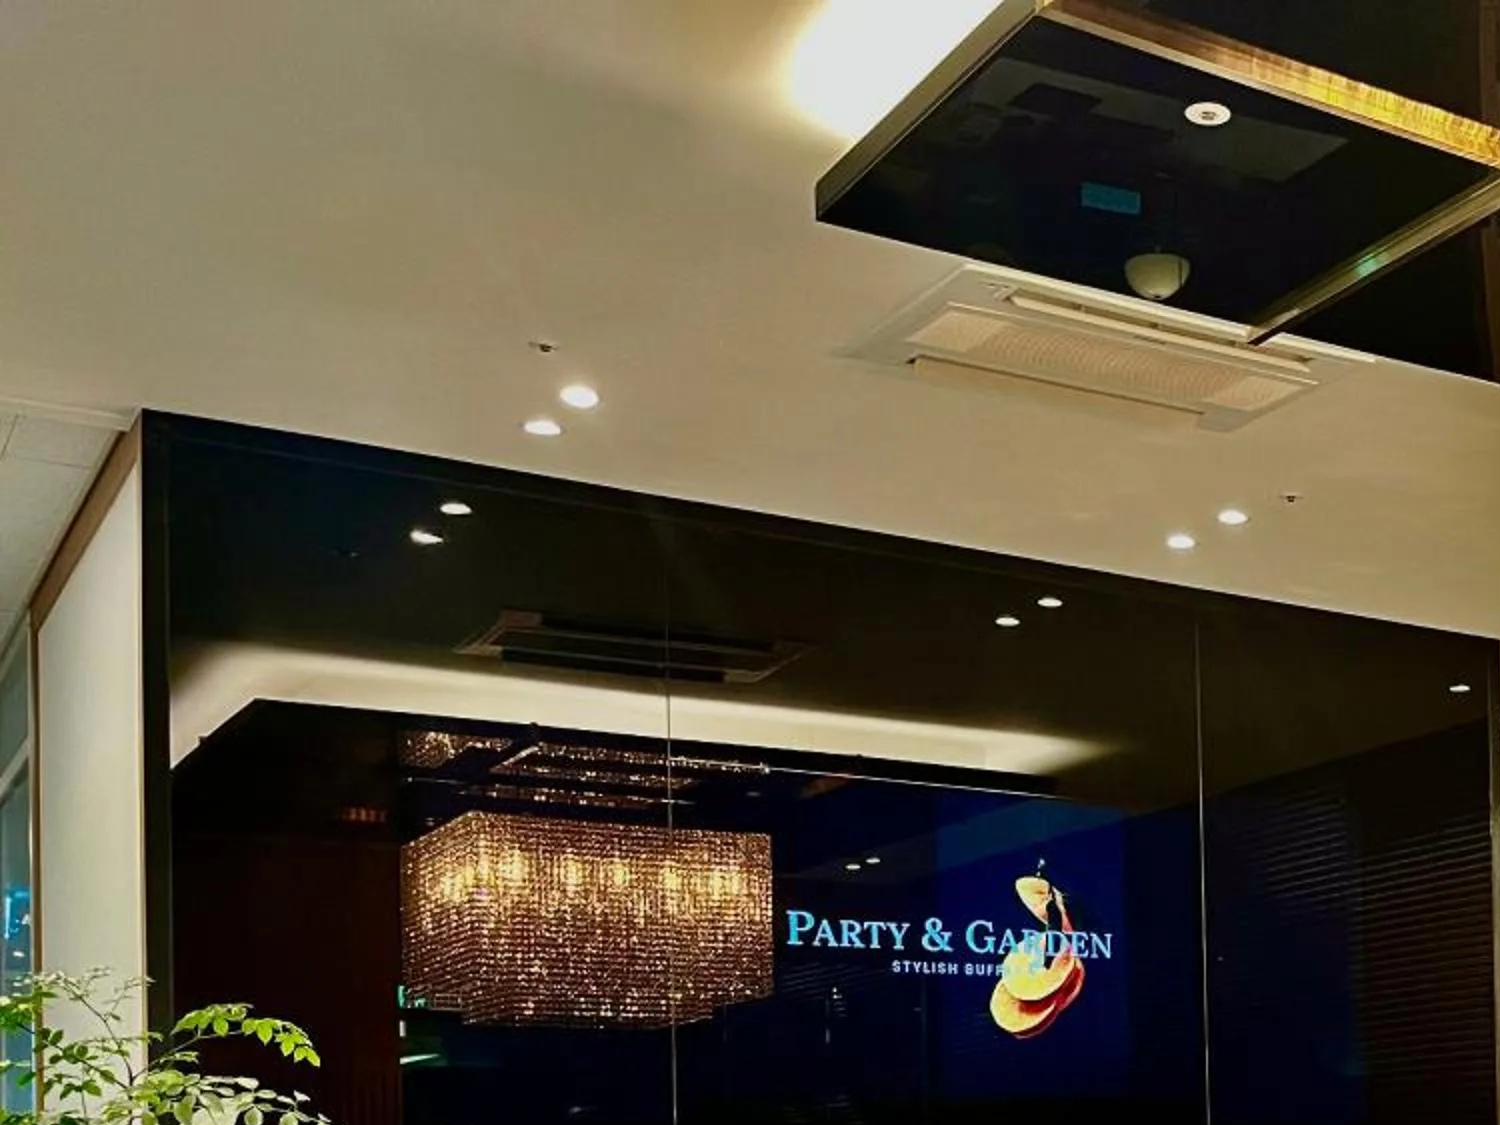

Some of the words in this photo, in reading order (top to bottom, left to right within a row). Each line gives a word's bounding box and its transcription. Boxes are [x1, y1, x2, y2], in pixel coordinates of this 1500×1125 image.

[786, 909, 911, 950] PARTY
[921, 917, 954, 952] &
[965, 919, 1113, 959] GARDEN
[891, 959, 959, 976] STYLISH
[964, 962, 1020, 979] BUFF
